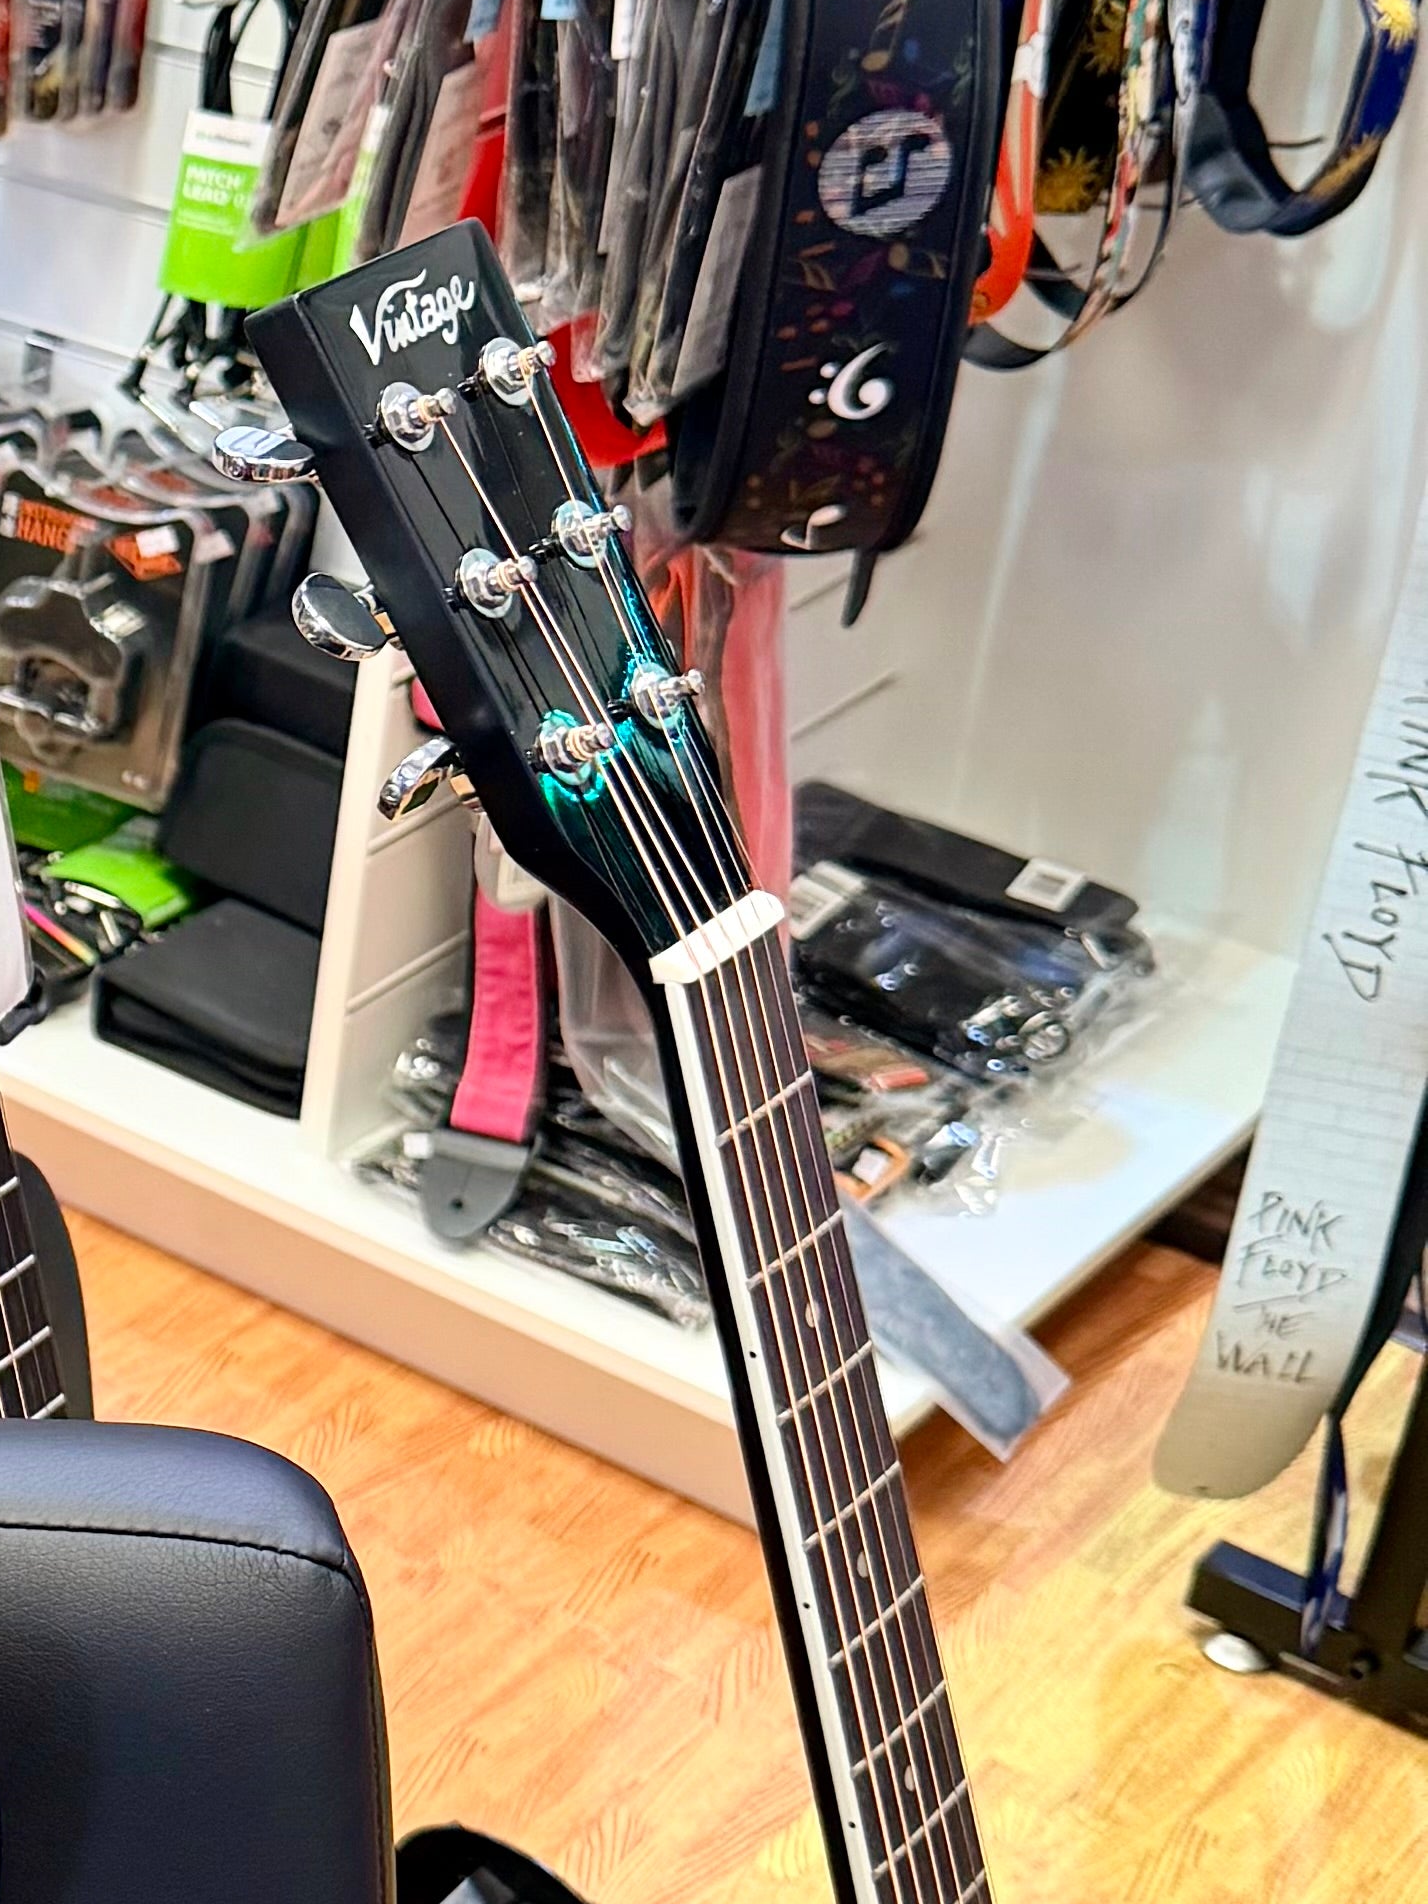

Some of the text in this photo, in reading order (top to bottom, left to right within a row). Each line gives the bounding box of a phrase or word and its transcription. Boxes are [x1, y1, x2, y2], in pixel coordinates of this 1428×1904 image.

[350, 267, 476, 366] Vintage
[1248, 1191, 1343, 1254] PINK
[1237, 1233, 1348, 1293] FLOYD
[1215, 1329, 1315, 1383] WALL
